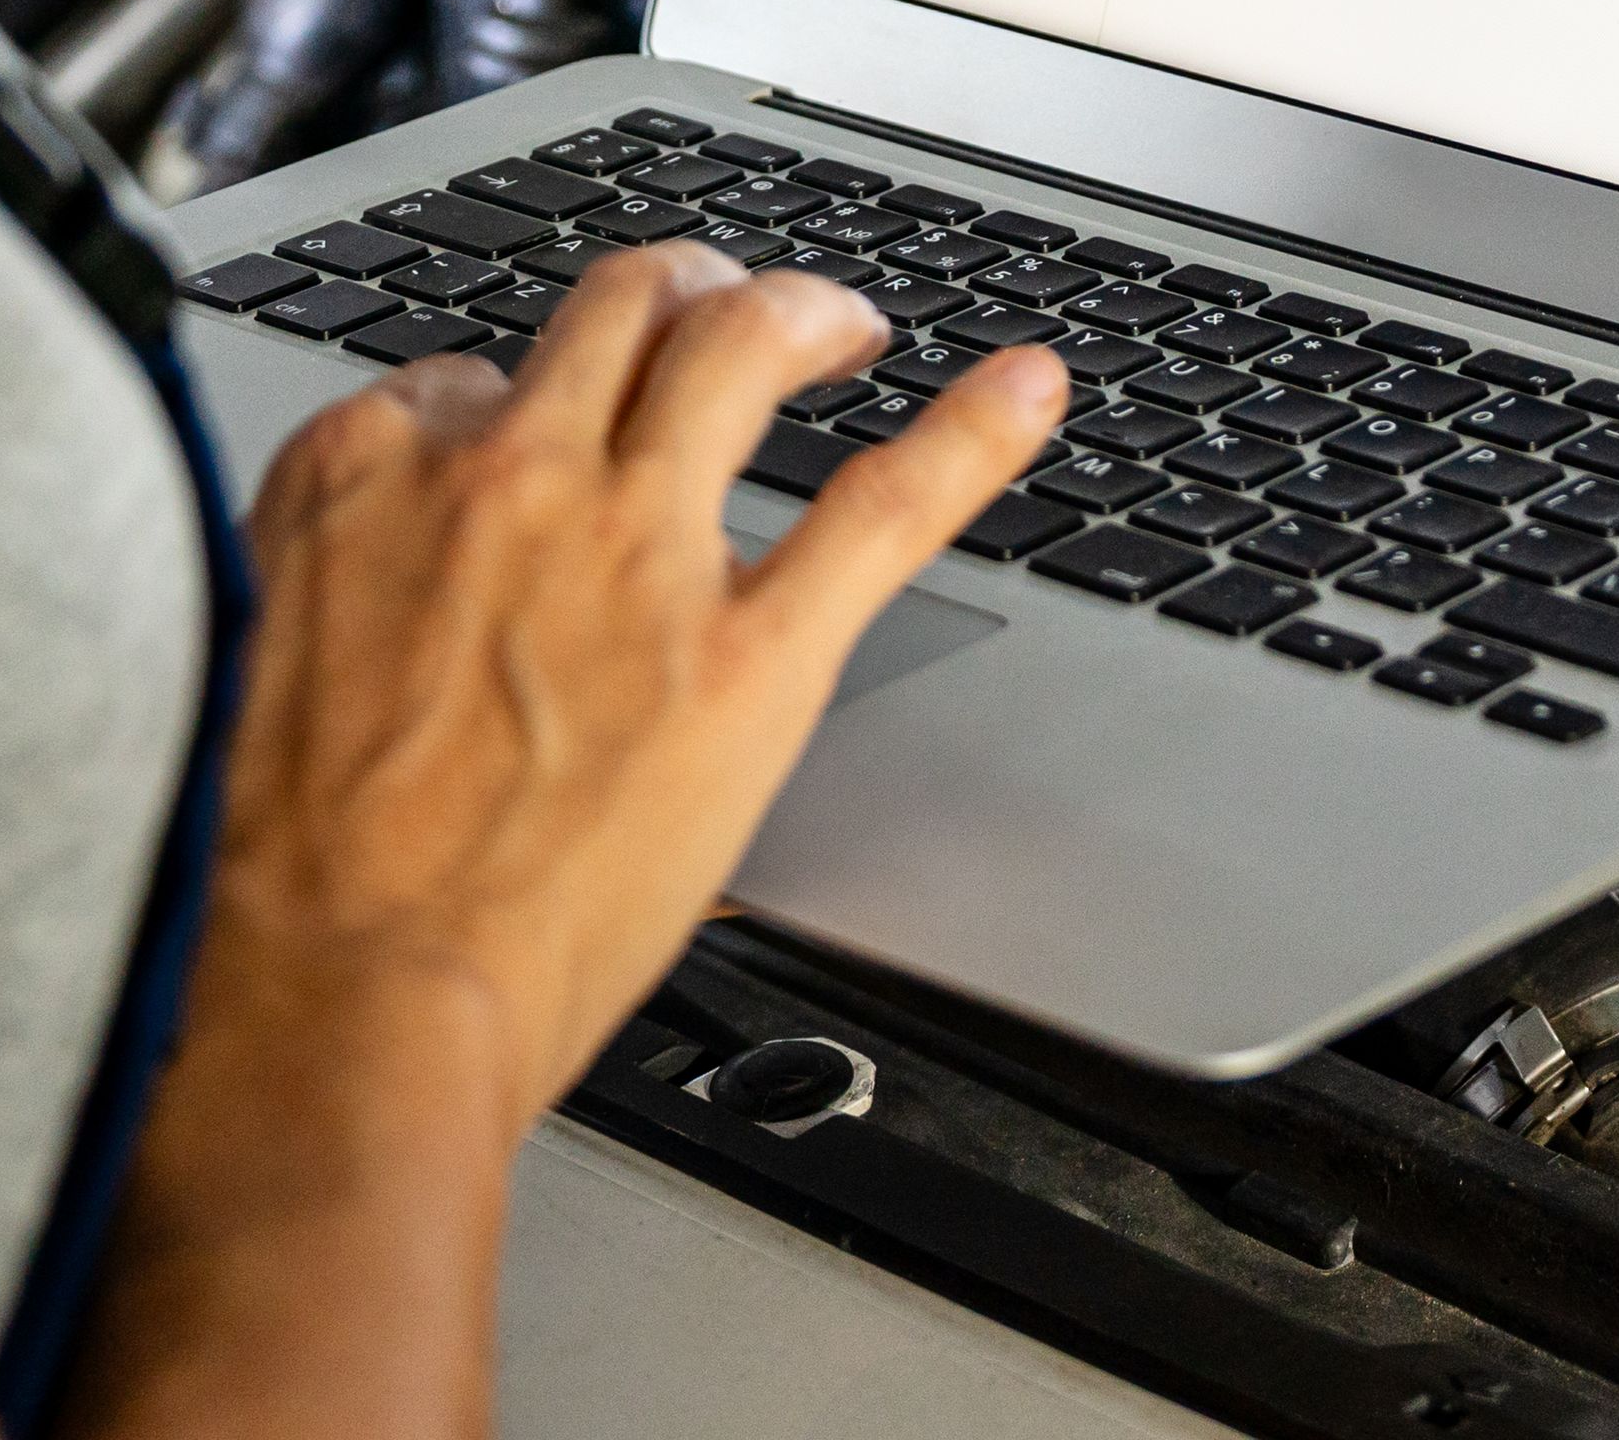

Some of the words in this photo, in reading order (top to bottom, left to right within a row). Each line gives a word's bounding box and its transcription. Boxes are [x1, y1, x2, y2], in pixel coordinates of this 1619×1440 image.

[750, 180, 774, 191] @
[716, 191, 741, 203] 2
[622, 200, 650, 214] Q
[834, 206, 860, 217] #
[805, 217, 829, 230] 3
[708, 225, 745, 241] W
[923, 231, 948, 243] $
[554, 239, 583, 252] A
[897, 244, 920, 255] 4
[795, 249, 822, 264] E
[1018, 257, 1044, 272] %
[986, 270, 1012, 282] 5
[514, 284, 547, 298] Z
[884, 277, 912, 291] R
[275, 302, 307, 315] ctrl
[1079, 299, 1102, 309] 6
[981, 305, 1008, 319] T
[1202, 312, 1226, 325] &
[1173, 324, 1200, 335] 7
[1077, 332, 1103, 346] Y
[921, 348, 950, 363] G
[1270, 353, 1294, 364] 8
[1169, 360, 1200, 376] U
[1369, 381, 1392, 393] 9
[880, 397, 908, 412] B
[1109, 406, 1136, 418] J
[1368, 420, 1396, 435] O
[1206, 434, 1240, 451] K
[1467, 448, 1497, 463] P
[1074, 457, 1113, 479] M
[1308, 464, 1330, 481] L
